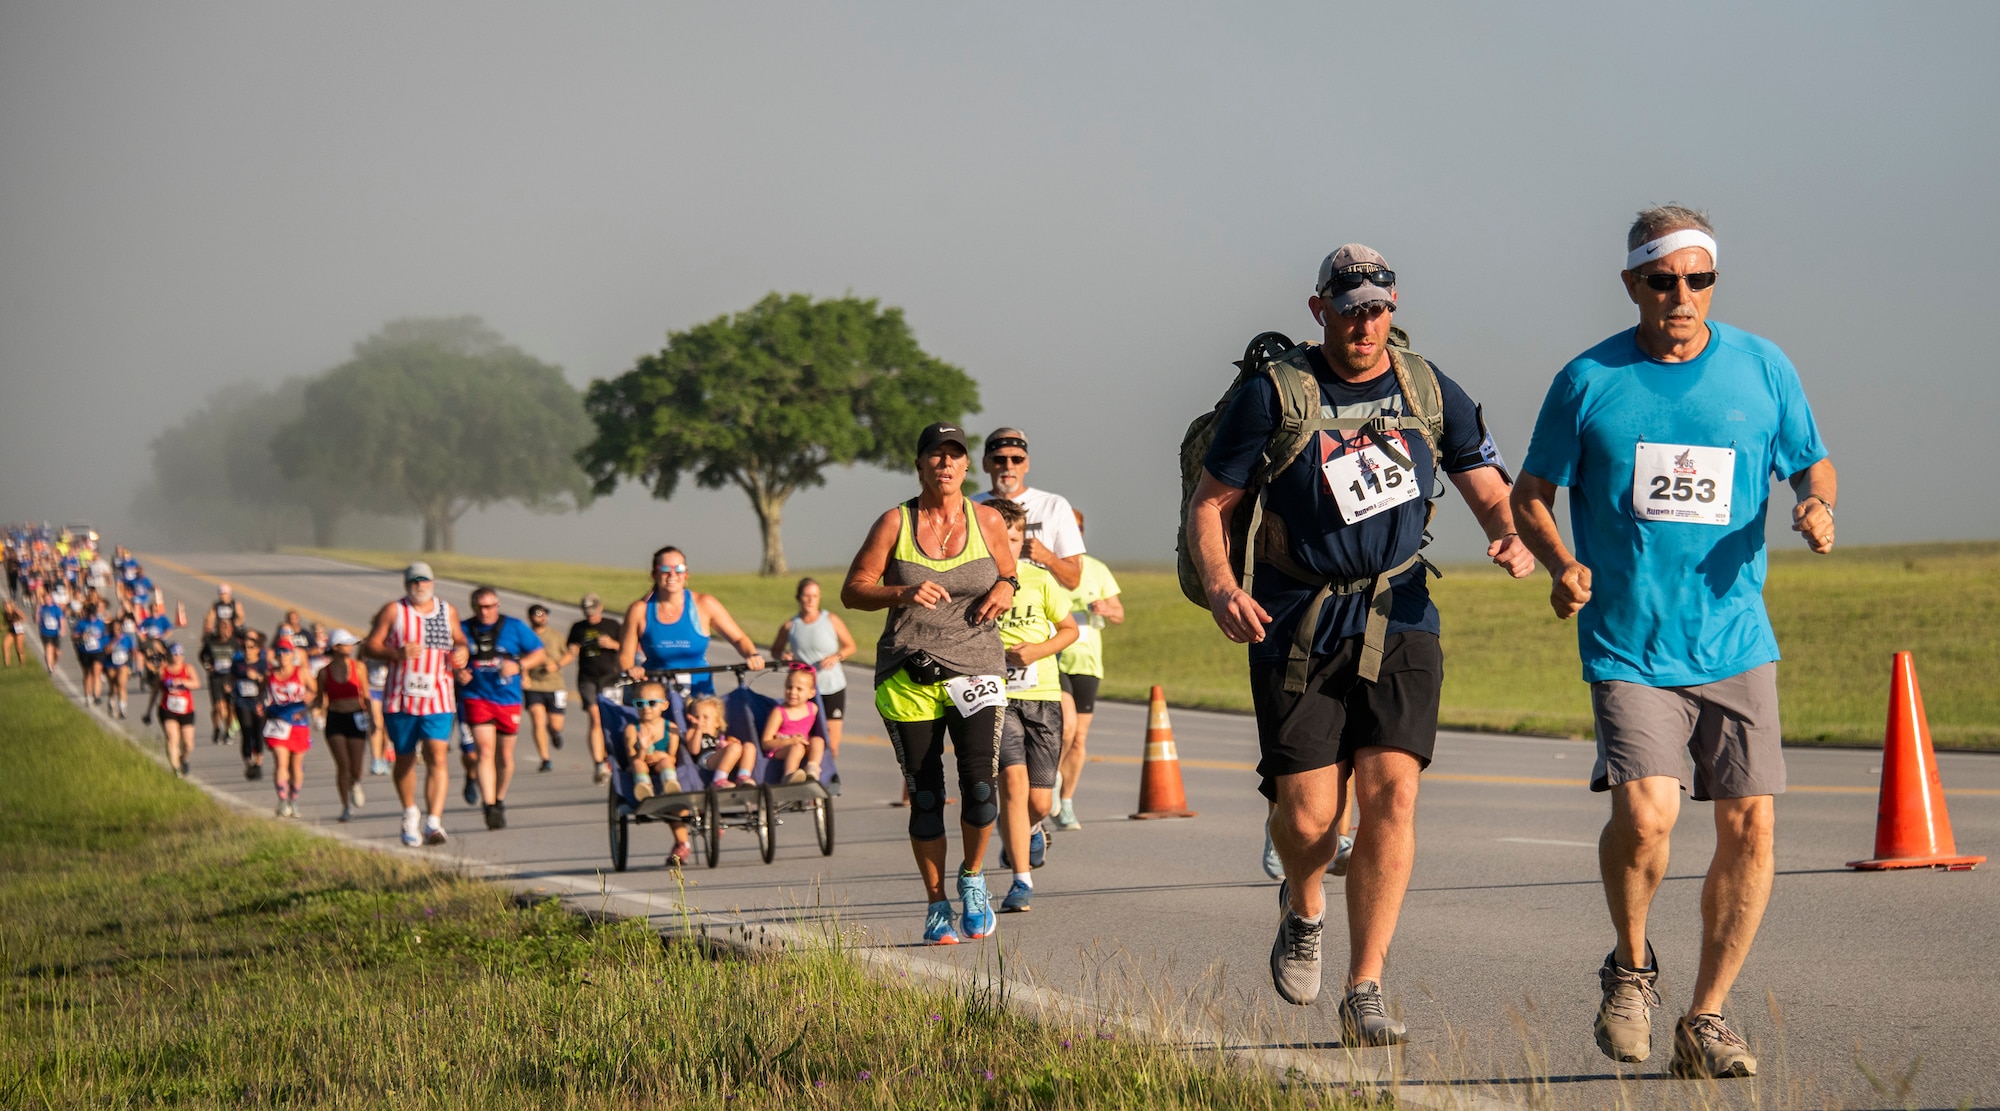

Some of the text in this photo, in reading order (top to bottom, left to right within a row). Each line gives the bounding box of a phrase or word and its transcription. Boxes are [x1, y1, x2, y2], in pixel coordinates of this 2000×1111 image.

[1348, 465, 1403, 502] 115
[1649, 475, 1716, 504] 253
[962, 681, 999, 703] 623
